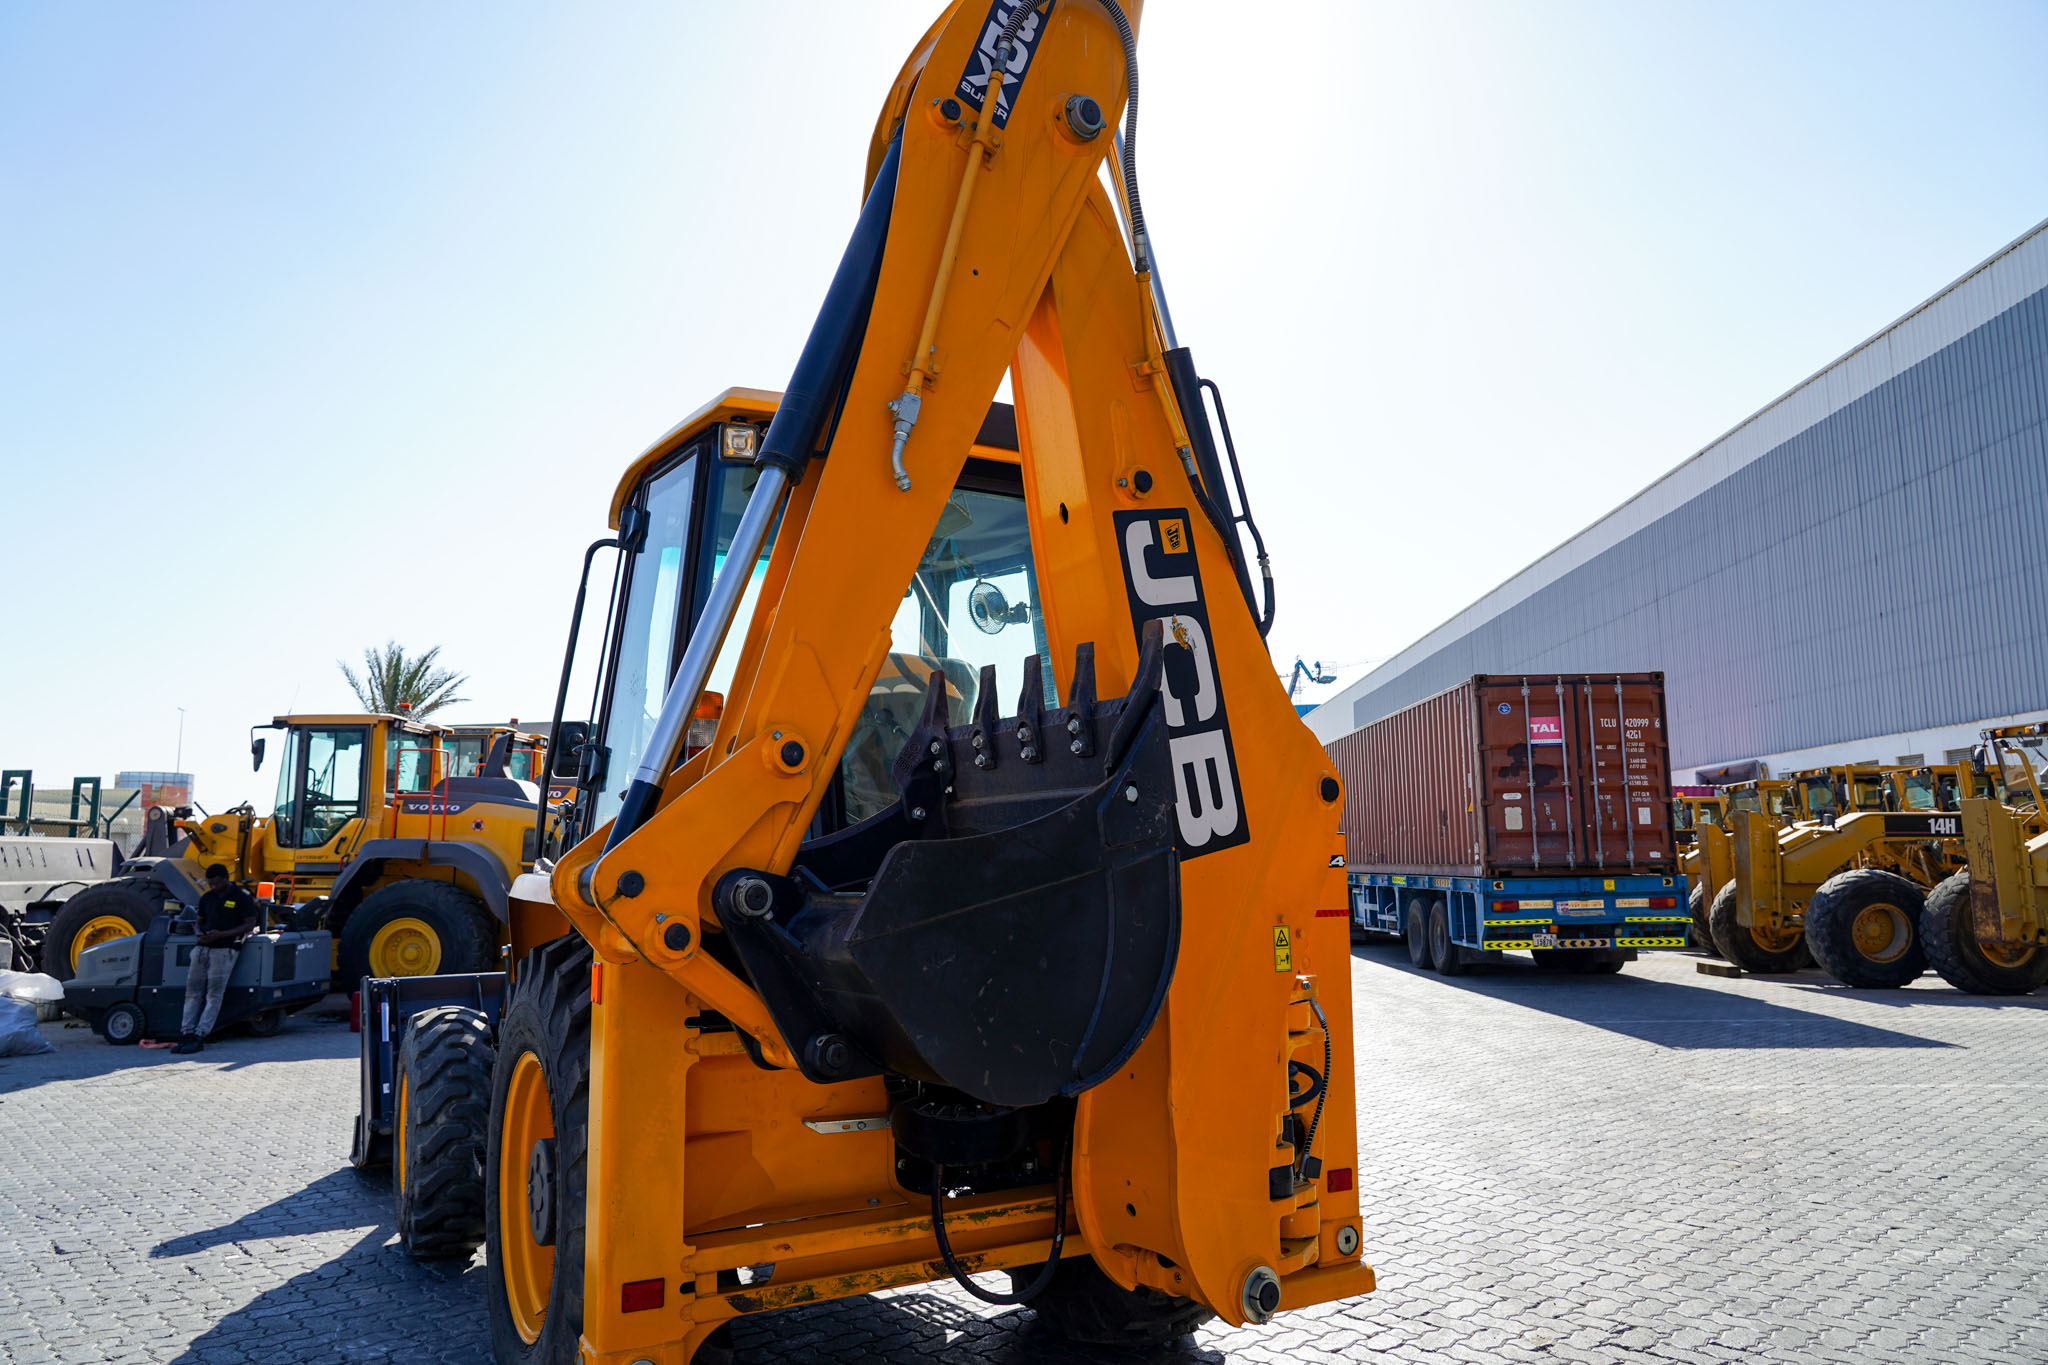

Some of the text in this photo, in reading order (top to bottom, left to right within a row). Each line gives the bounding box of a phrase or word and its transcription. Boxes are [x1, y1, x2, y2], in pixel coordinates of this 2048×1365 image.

[1166, 528, 1180, 548] JCB
[1125, 519, 1239, 847] JCB
[1530, 723, 1560, 733] TAL
[1600, 718, 1660, 728] TCLU 420999 6
[1625, 729, 1642, 739] 42G1
[408, 803, 460, 812] VOLVO
[1927, 817, 1956, 834] 14H
